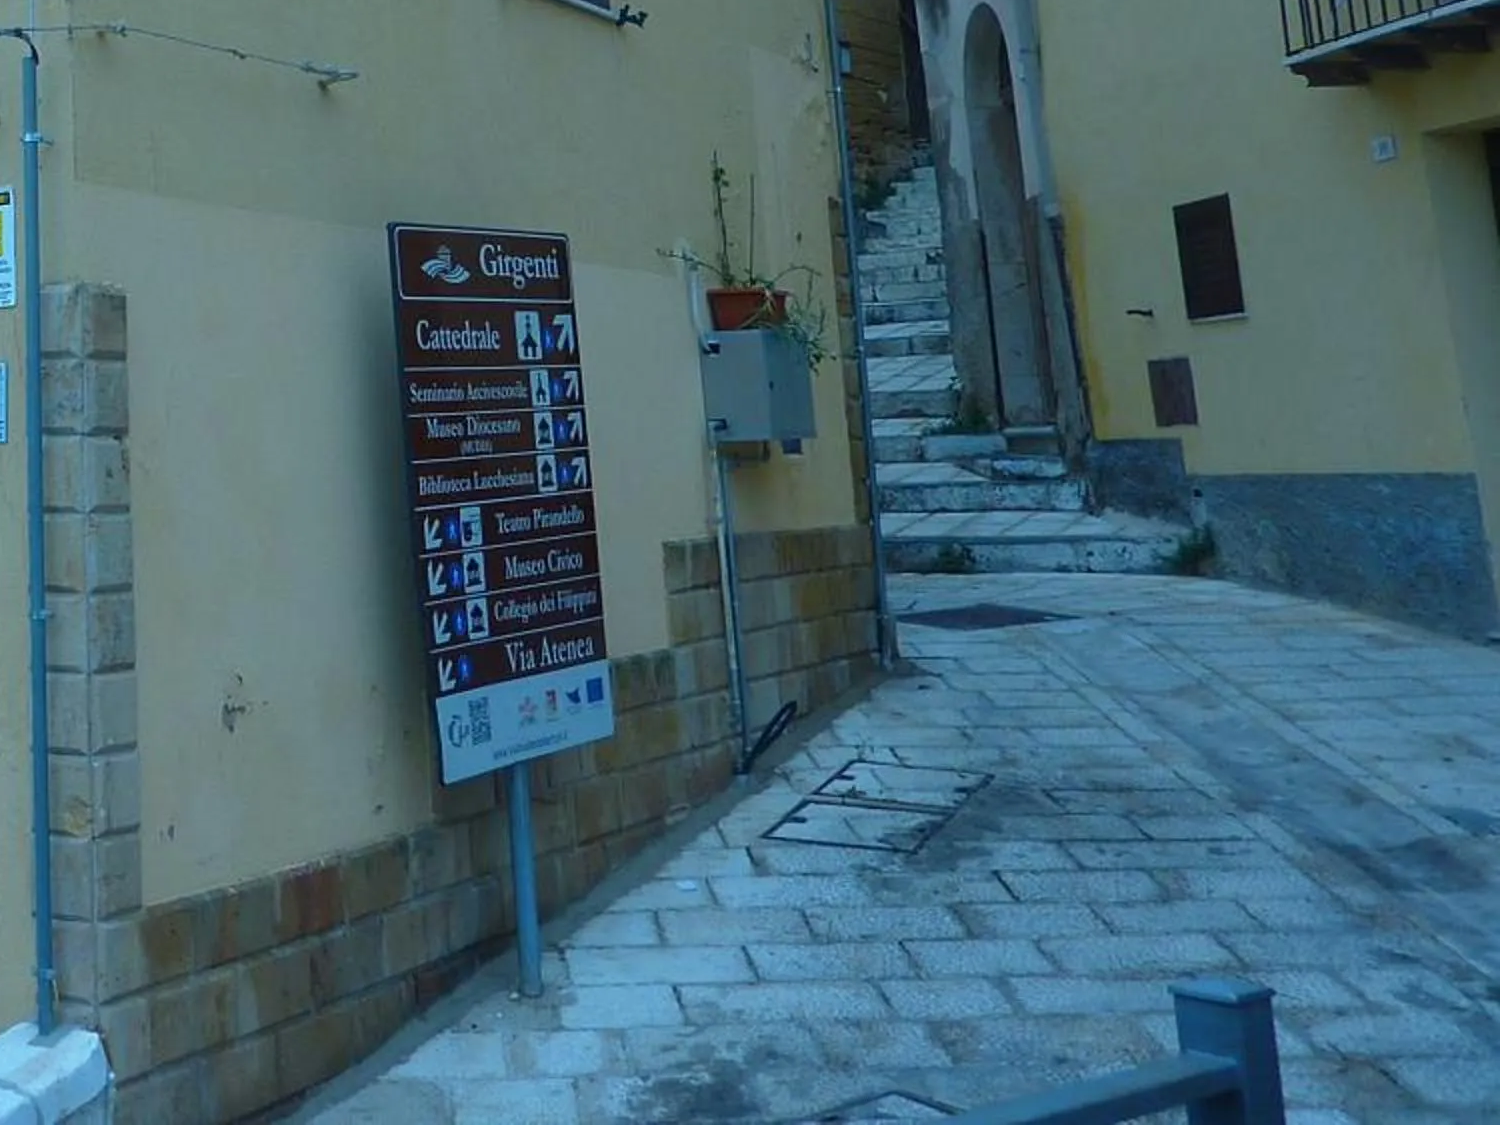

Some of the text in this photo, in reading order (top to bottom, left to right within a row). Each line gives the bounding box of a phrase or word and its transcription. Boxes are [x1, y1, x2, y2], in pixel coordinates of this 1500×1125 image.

[479, 243, 560, 290] Girgenti
[416, 319, 501, 351] Cattedrale
[409, 382, 465, 403] Seminario
[426, 416, 521, 439] Museo Diocesano
[419, 475, 472, 496] Biblioteca
[494, 504, 585, 534] Teatro Pirandello
[504, 548, 583, 580] Museo Civico
[494, 596, 539, 623] Collegio
[540, 593, 556, 614] dei
[504, 635, 595, 674] Via Atenea
